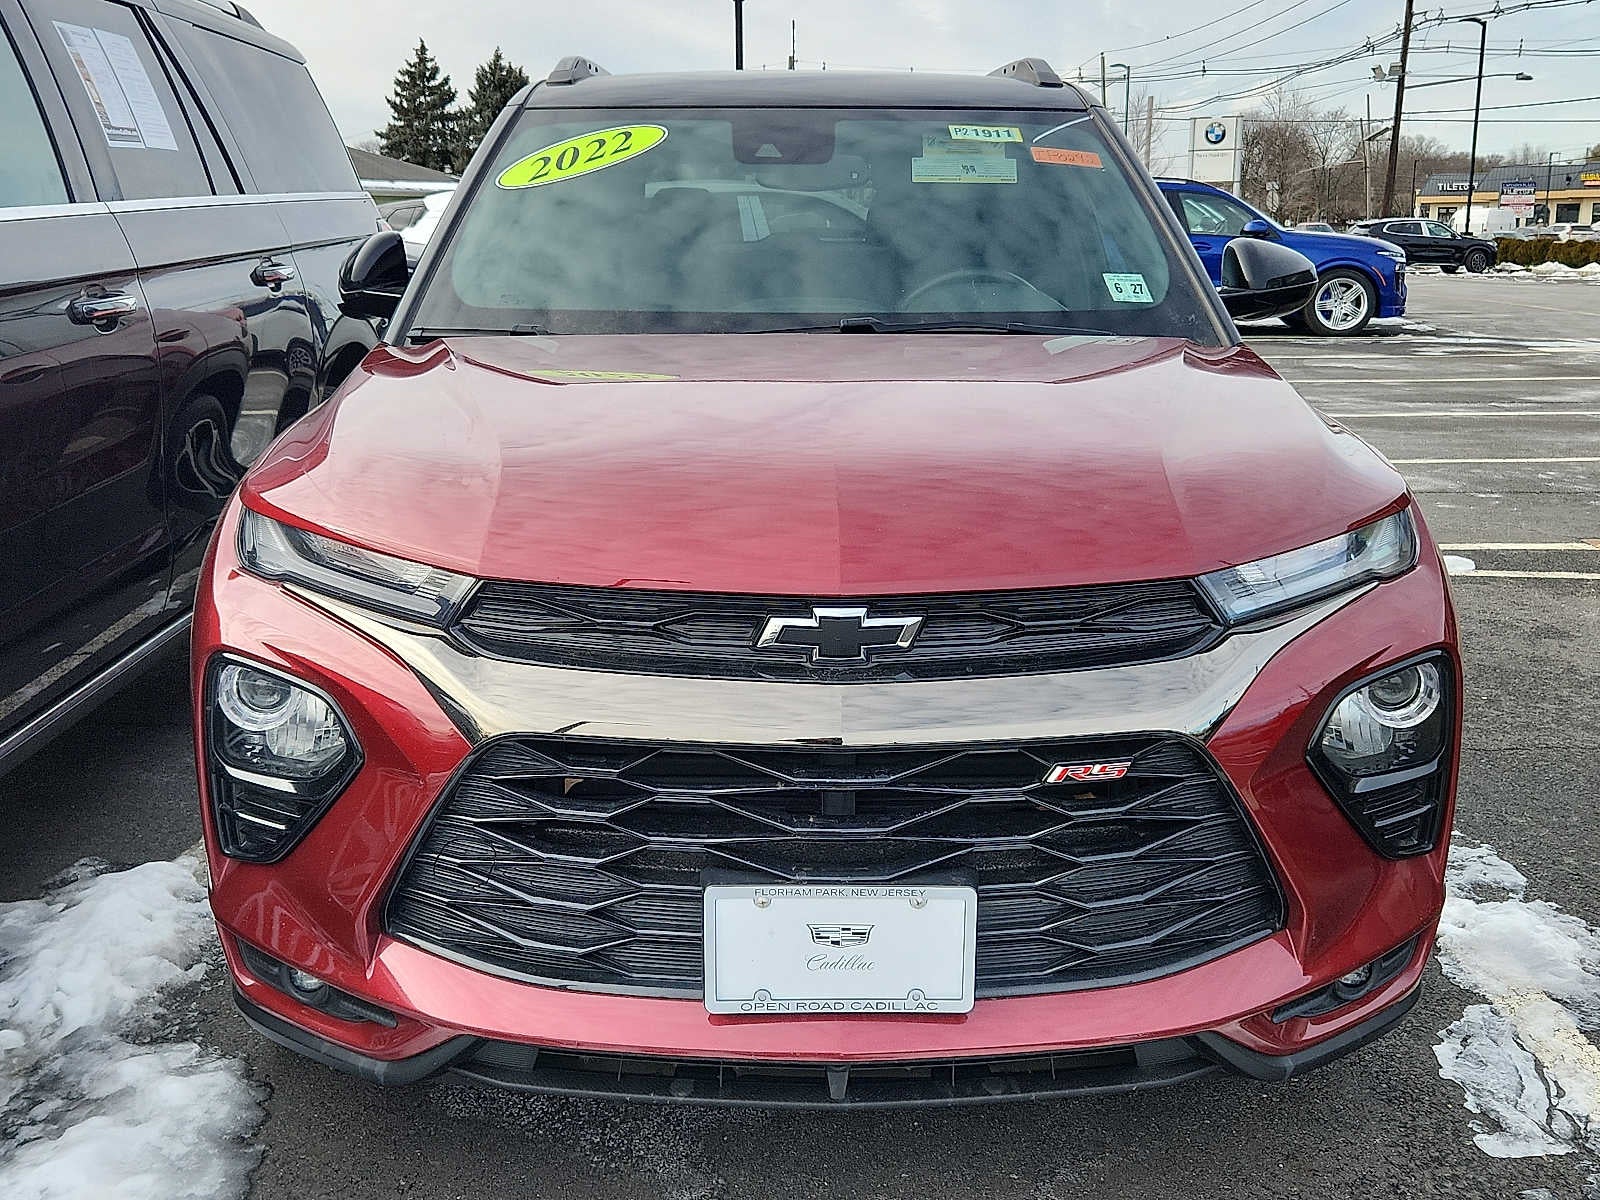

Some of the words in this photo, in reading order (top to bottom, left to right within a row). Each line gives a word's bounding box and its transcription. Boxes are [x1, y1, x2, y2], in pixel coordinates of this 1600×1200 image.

[527, 131, 633, 183] 2022
[1114, 283, 1123, 293] 6
[1130, 284, 1143, 294] 27
[1046, 761, 1132, 783] RS
[754, 888, 812, 897] FLORHAM
[851, 888, 880, 897] NEW
[881, 888, 927, 897] JERSEY
[805, 953, 876, 972] Cadillac
[740, 1001, 790, 1012] OPEN
[796, 1001, 844, 1012] ROAD
[850, 1001, 939, 1012] CADILLAC
